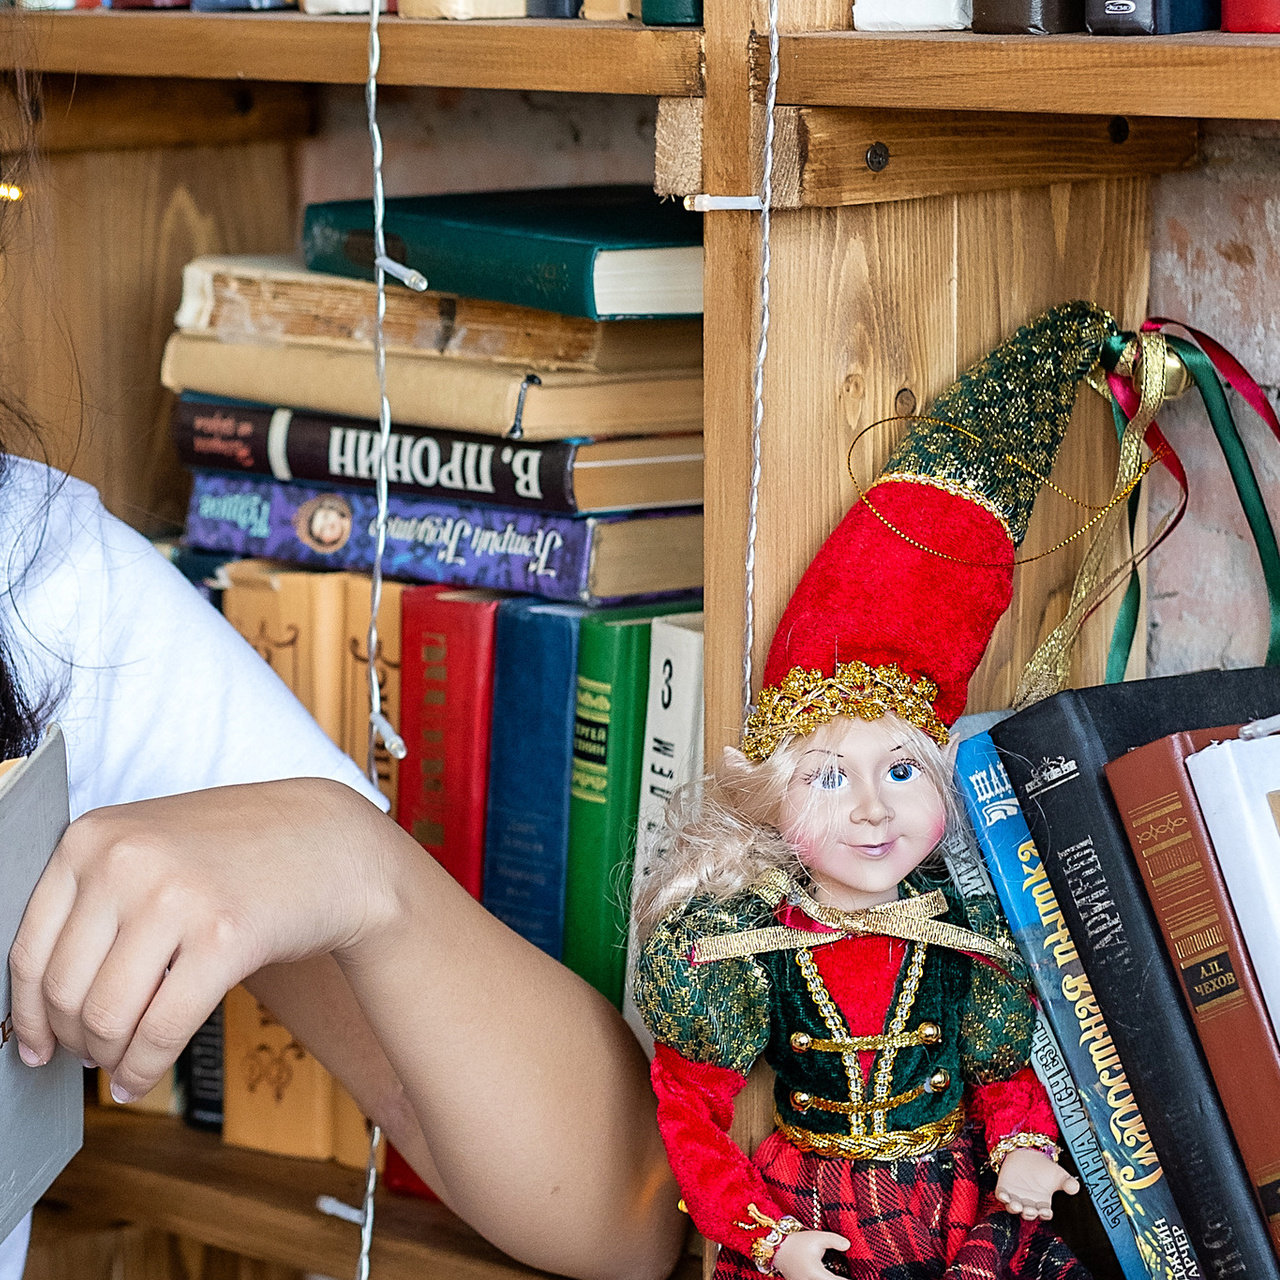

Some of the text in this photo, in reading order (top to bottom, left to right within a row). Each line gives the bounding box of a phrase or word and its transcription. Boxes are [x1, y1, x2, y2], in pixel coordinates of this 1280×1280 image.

[328, 424, 497, 494] ПРОНИН
[500, 445, 544, 501] В.
[660, 658, 674, 710] 3
[649, 736, 675, 803] ЛЕМ
[1193, 971, 1237, 998] ЧЕХОВ
[1199, 960, 1224, 980] А.П.
[1070, 1129, 1122, 1229] ТАЙНА
[1171, 1224, 1201, 1278] АРЧЕР
